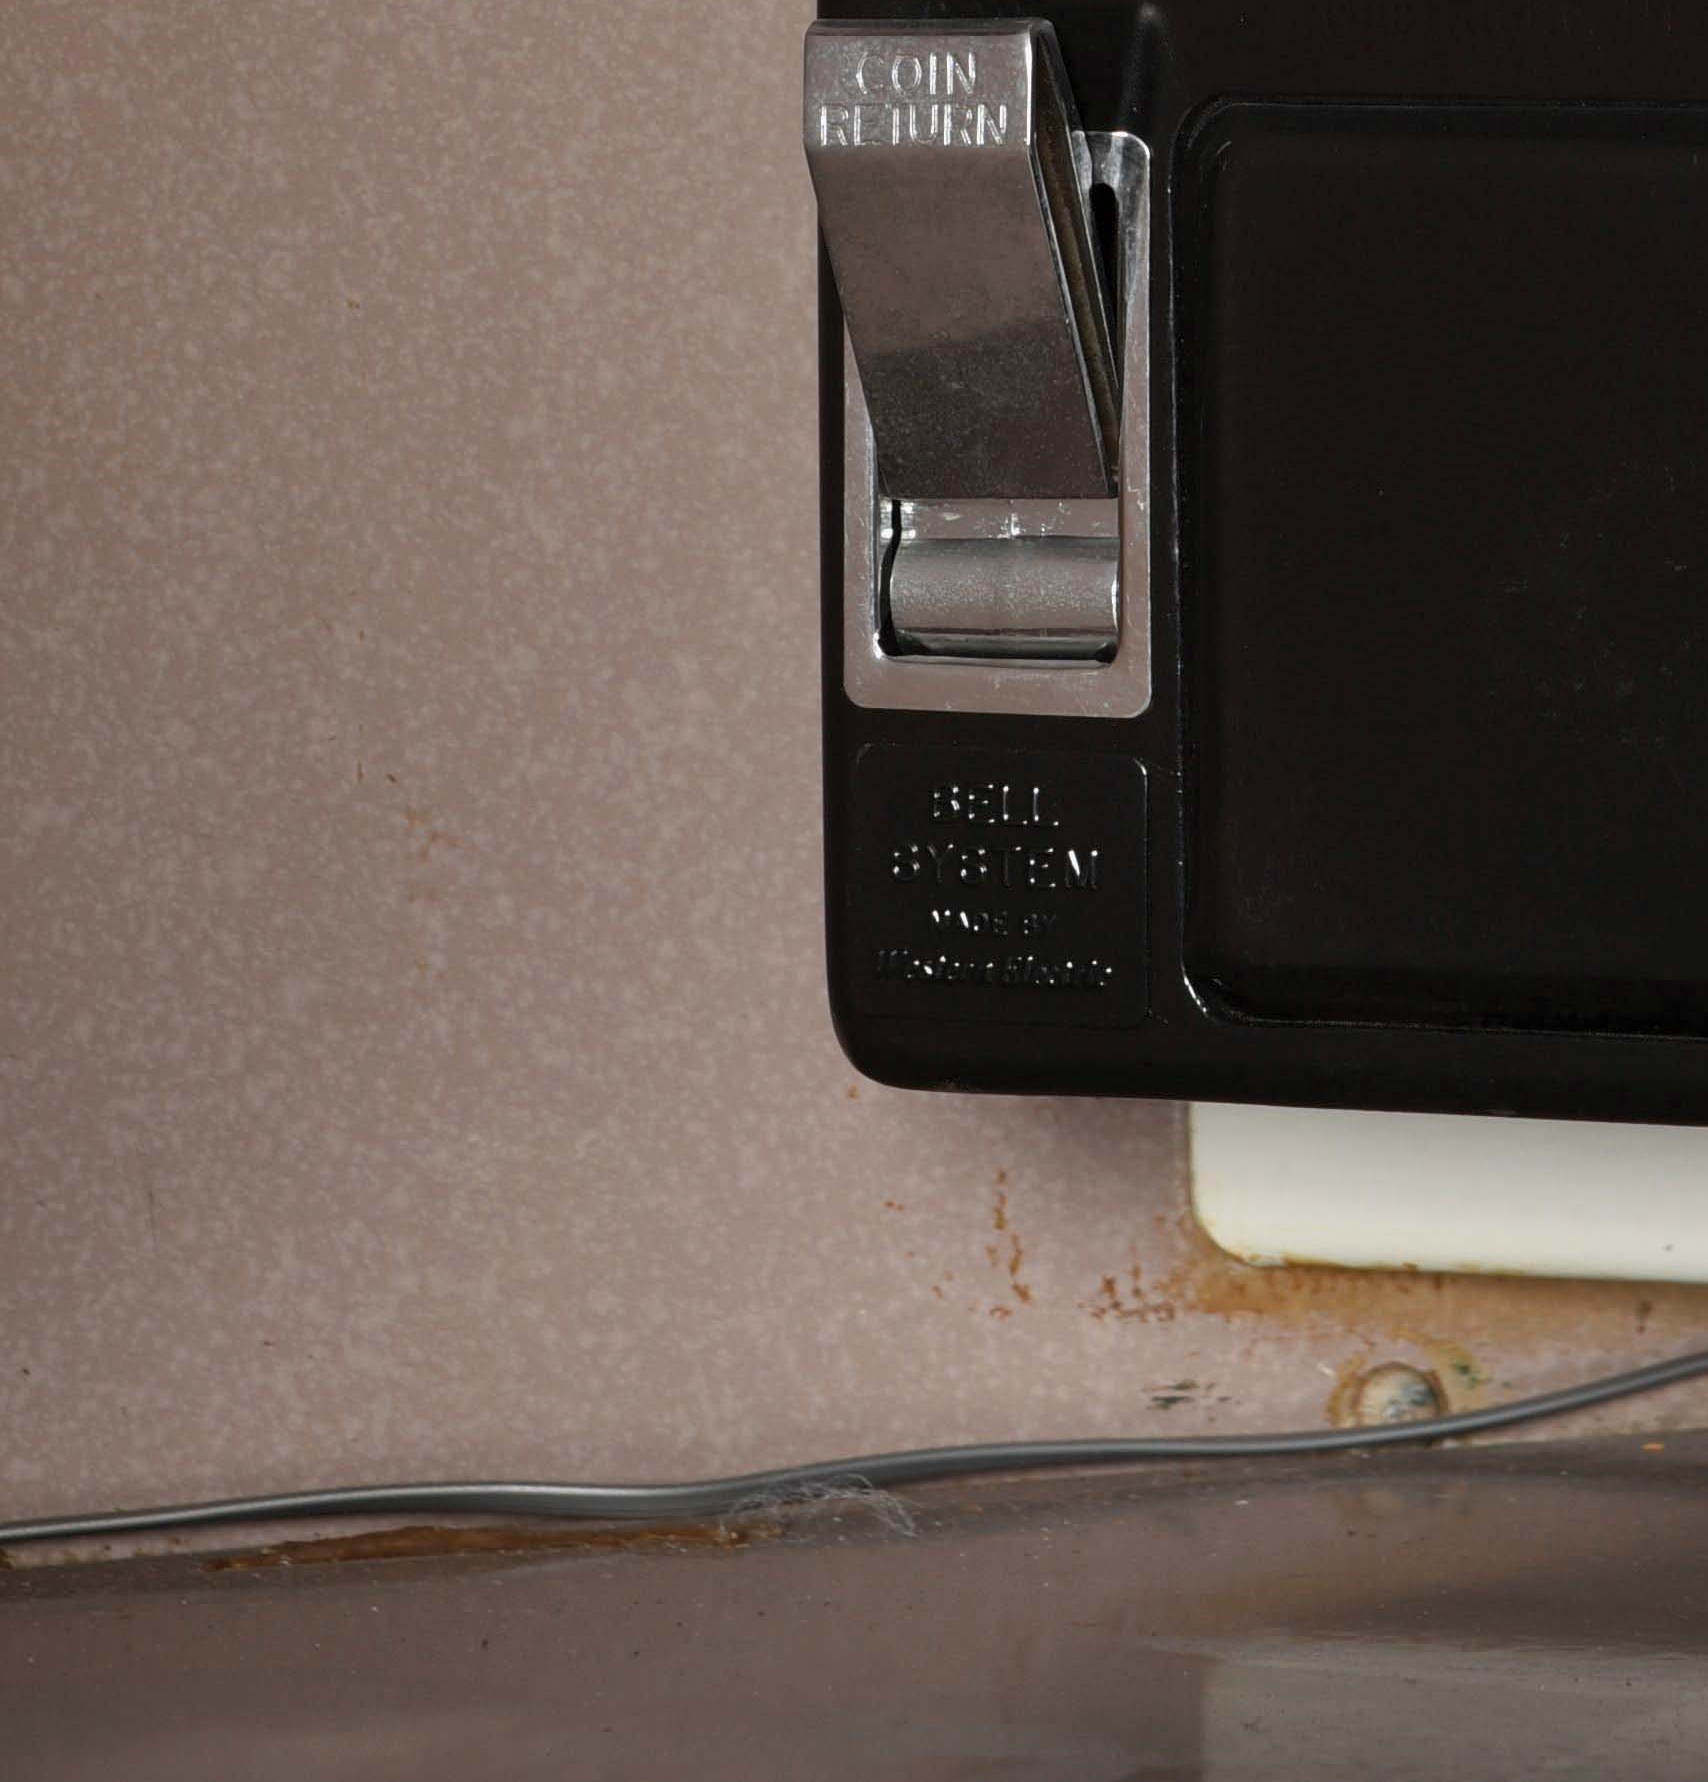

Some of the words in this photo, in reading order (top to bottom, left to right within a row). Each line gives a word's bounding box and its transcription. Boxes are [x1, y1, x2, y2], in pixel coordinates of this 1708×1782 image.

[855, 50, 978, 96] COIN
[818, 103, 1008, 147] RETURN
[930, 782, 1060, 827] BELL
[889, 842, 1100, 889] SYSTEM
